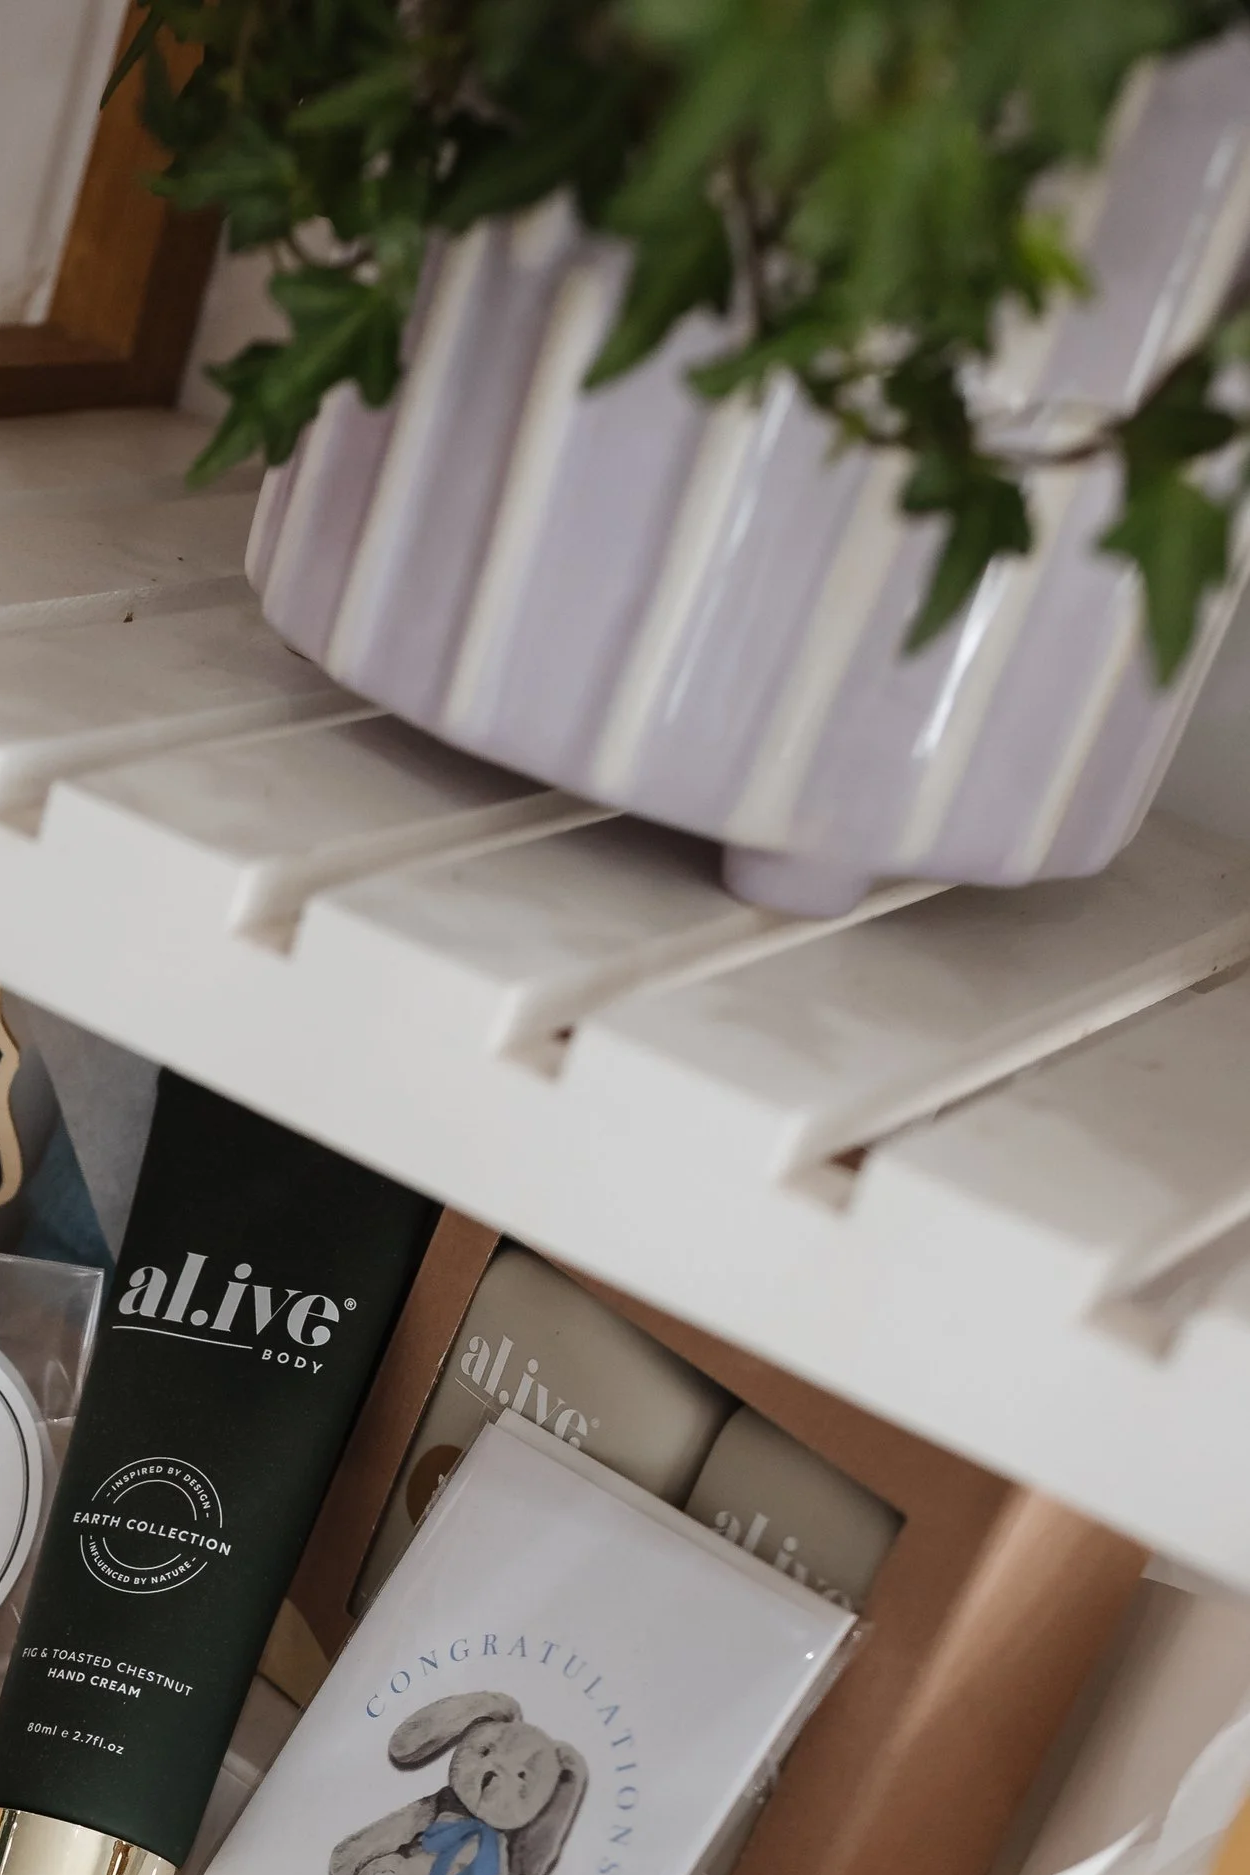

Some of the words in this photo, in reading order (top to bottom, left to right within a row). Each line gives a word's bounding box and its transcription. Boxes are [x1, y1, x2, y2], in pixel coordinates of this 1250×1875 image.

[261, 1349, 324, 1375] BODY
[111, 1465, 163, 1492] INSPIRED
[167, 1466, 182, 1477] BY
[183, 1474, 211, 1510] DESIGN
[72, 1512, 121, 1528] EARTH
[126, 1519, 232, 1556] COLLECTION
[88, 1541, 130, 1583] INFLUENCED
[133, 1577, 147, 1585] BY
[151, 1560, 192, 1584] NATURE
[22, 1647, 38, 1658] FIG
[40, 1648, 48, 1658] &
[52, 1648, 112, 1669] TOASTED
[116, 1662, 193, 1697] CHESTNUT
[47, 1667, 86, 1683] HAND
[90, 1675, 141, 1698] CREAM
[27, 1722, 58, 1736] 80ml
[72, 1730, 125, 1755] 2.7fl.oz
[366, 1633, 640, 1875] CONGRATULATIONS
